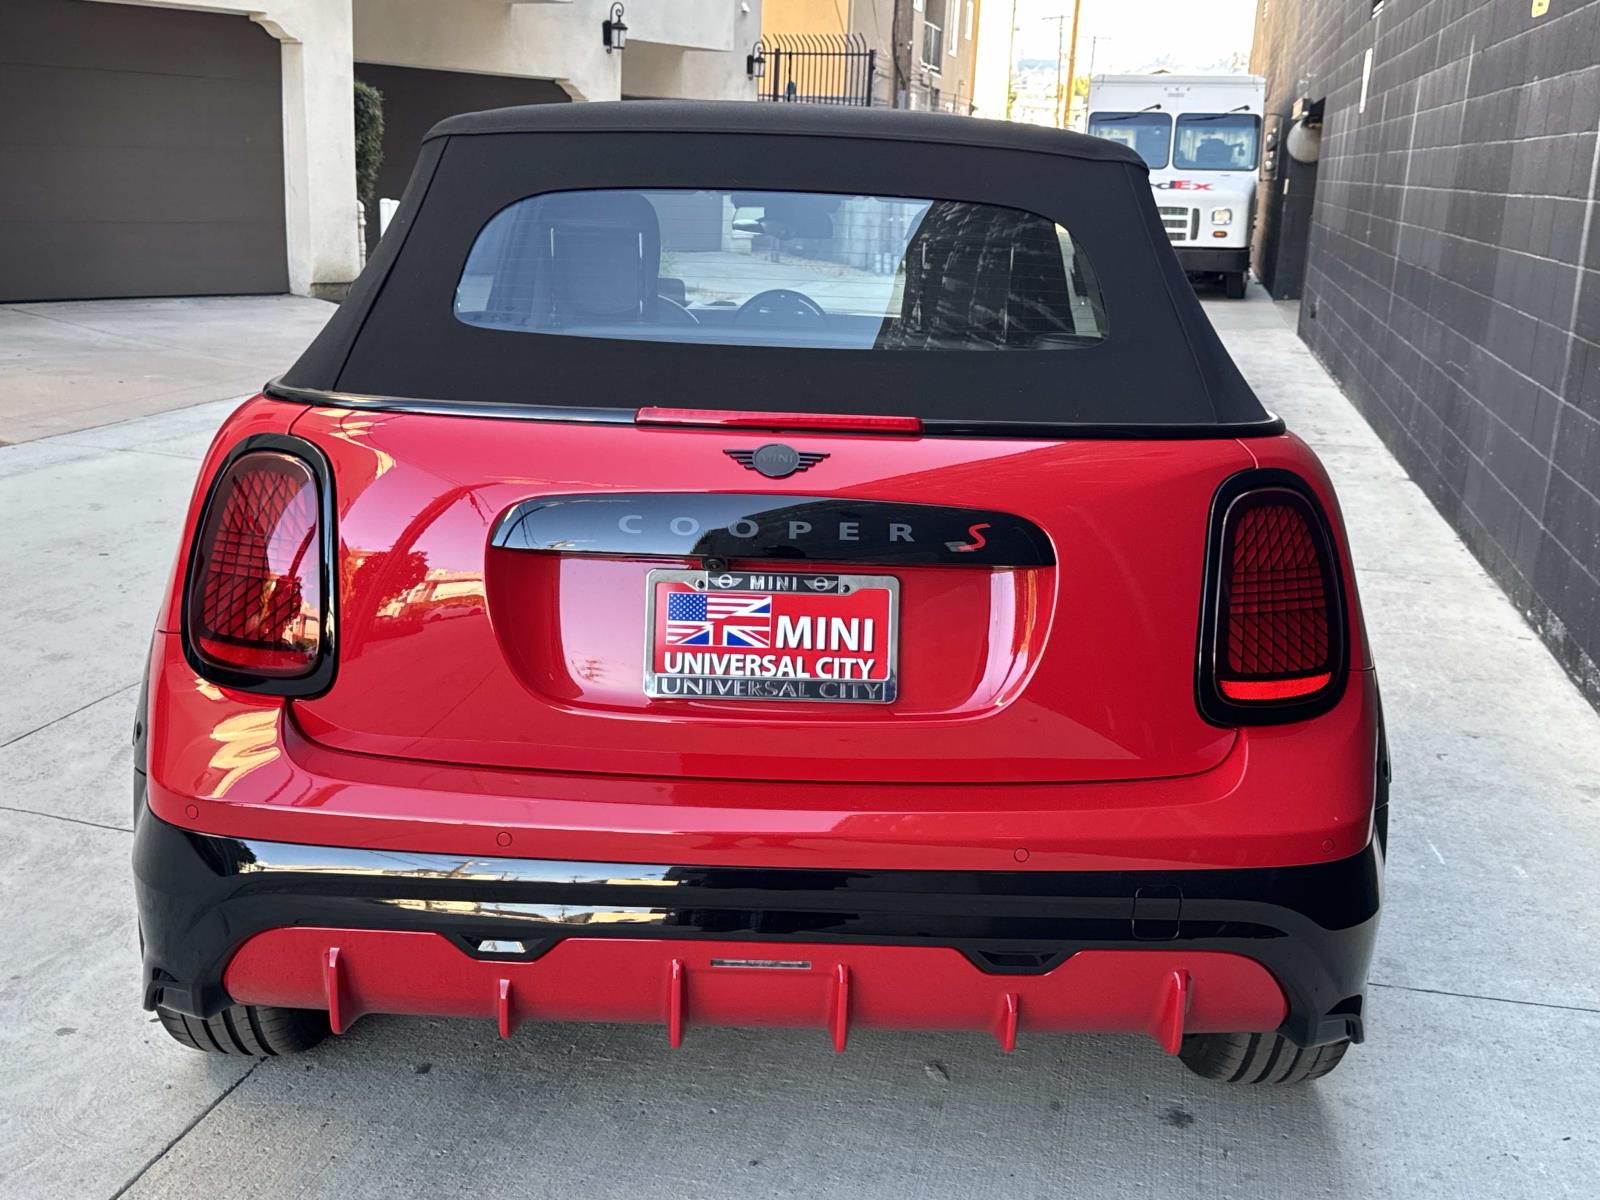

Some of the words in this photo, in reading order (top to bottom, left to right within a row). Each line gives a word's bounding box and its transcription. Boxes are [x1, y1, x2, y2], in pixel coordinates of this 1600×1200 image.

[758, 453, 794, 464] MINI
[618, 514, 915, 543] COOPER
[957, 523, 991, 552] S
[750, 575, 798, 591] MINI
[775, 615, 874, 651] MINI
[664, 651, 810, 679] UNIVERSAL
[815, 656, 875, 680] CITY
[661, 677, 811, 698] UNIVERSAL
[819, 682, 882, 699] CITY
